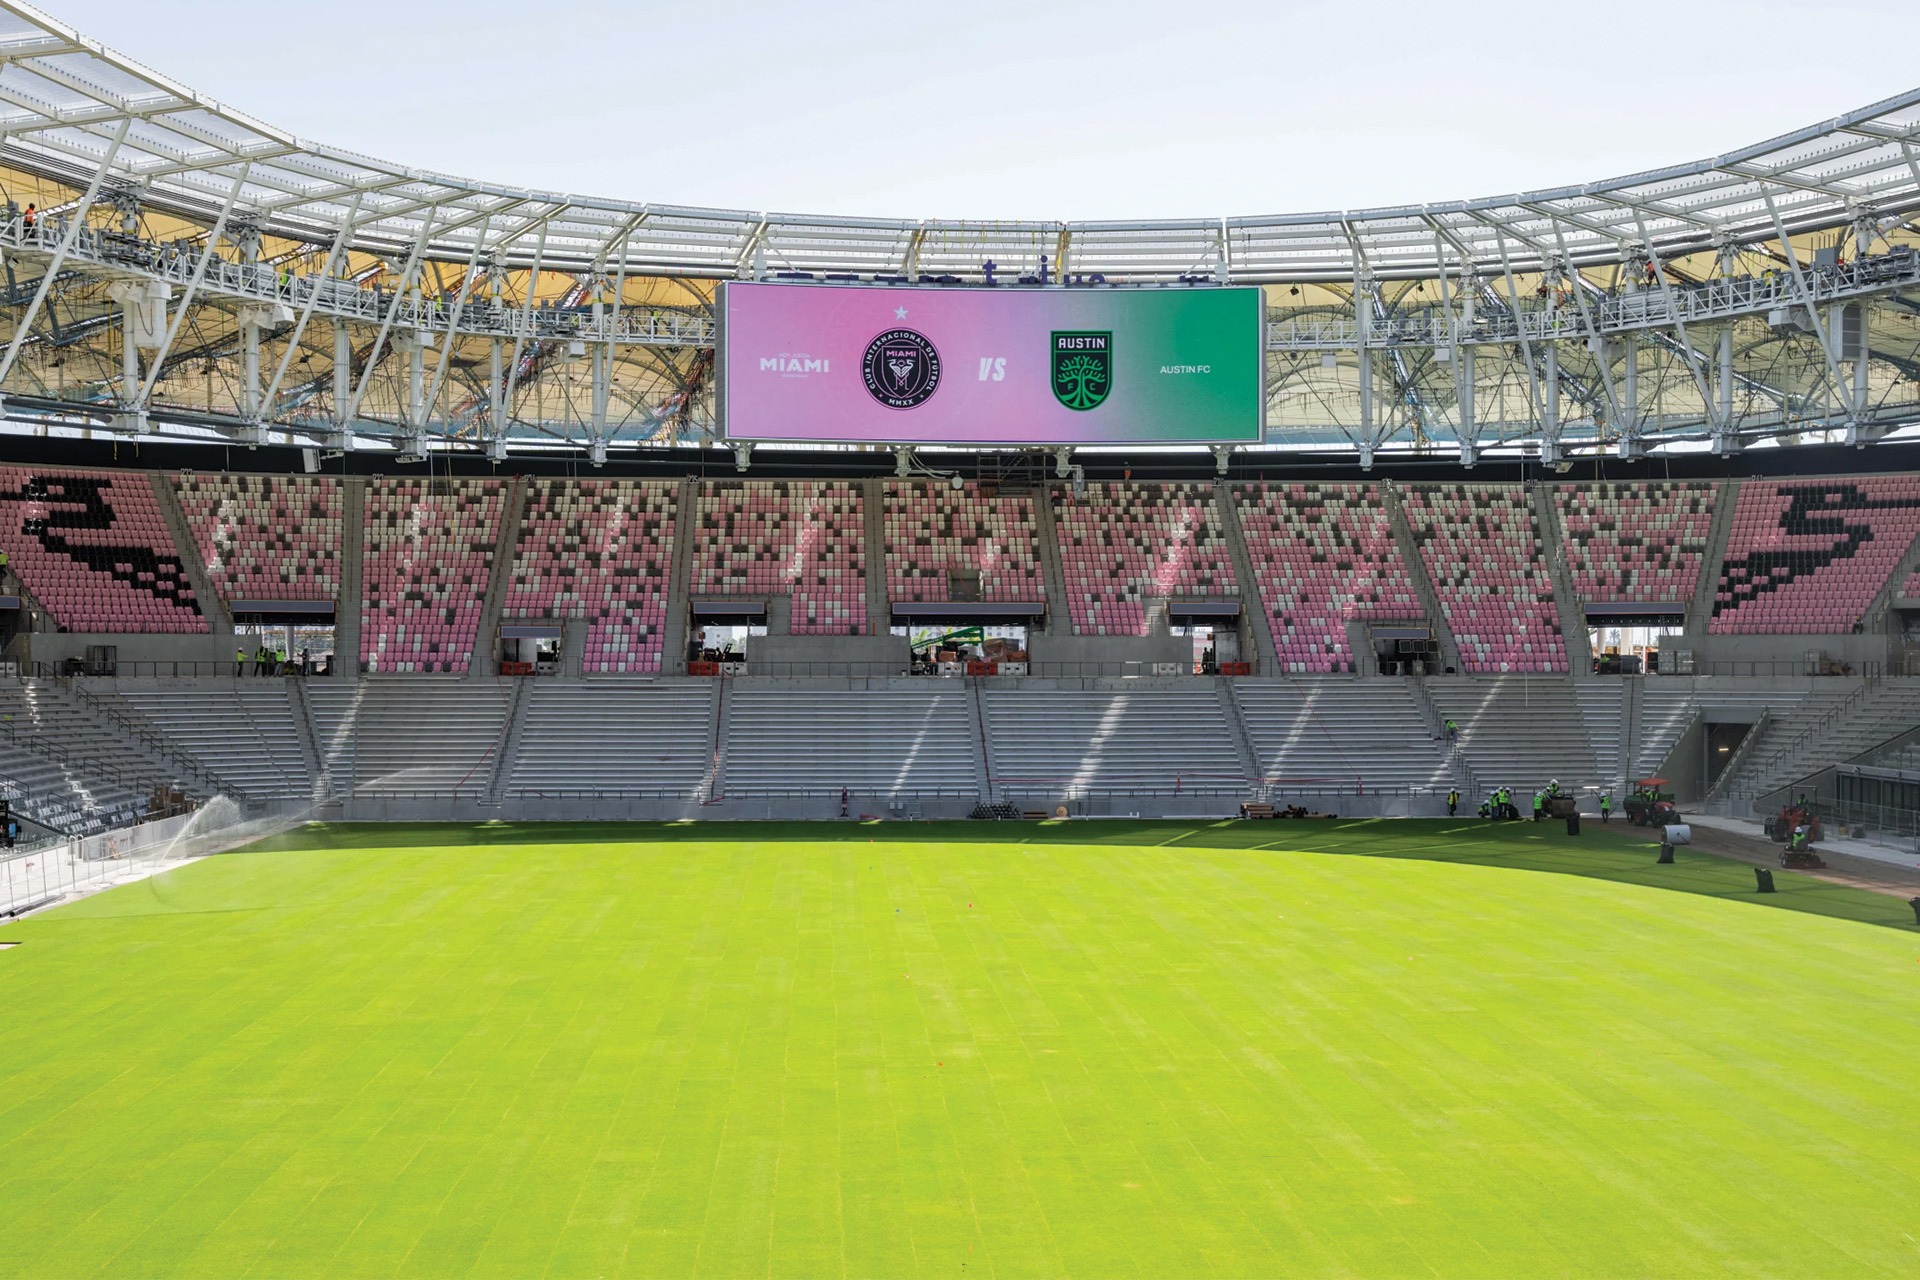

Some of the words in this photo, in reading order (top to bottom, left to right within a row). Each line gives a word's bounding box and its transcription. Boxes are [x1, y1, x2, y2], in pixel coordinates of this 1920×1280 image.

[865, 332, 925, 364] INTERNACIONAL
[1058, 337, 1105, 349] AUSTIN
[925, 347, 935, 357] DE
[759, 357, 829, 373] MIAMI
[978, 357, 1007, 382] VS
[1160, 365, 1195, 374] AUSTIN
[1197, 364, 1211, 374] FC
[864, 368, 876, 390] CLUB
[888, 398, 914, 406] MMXX
